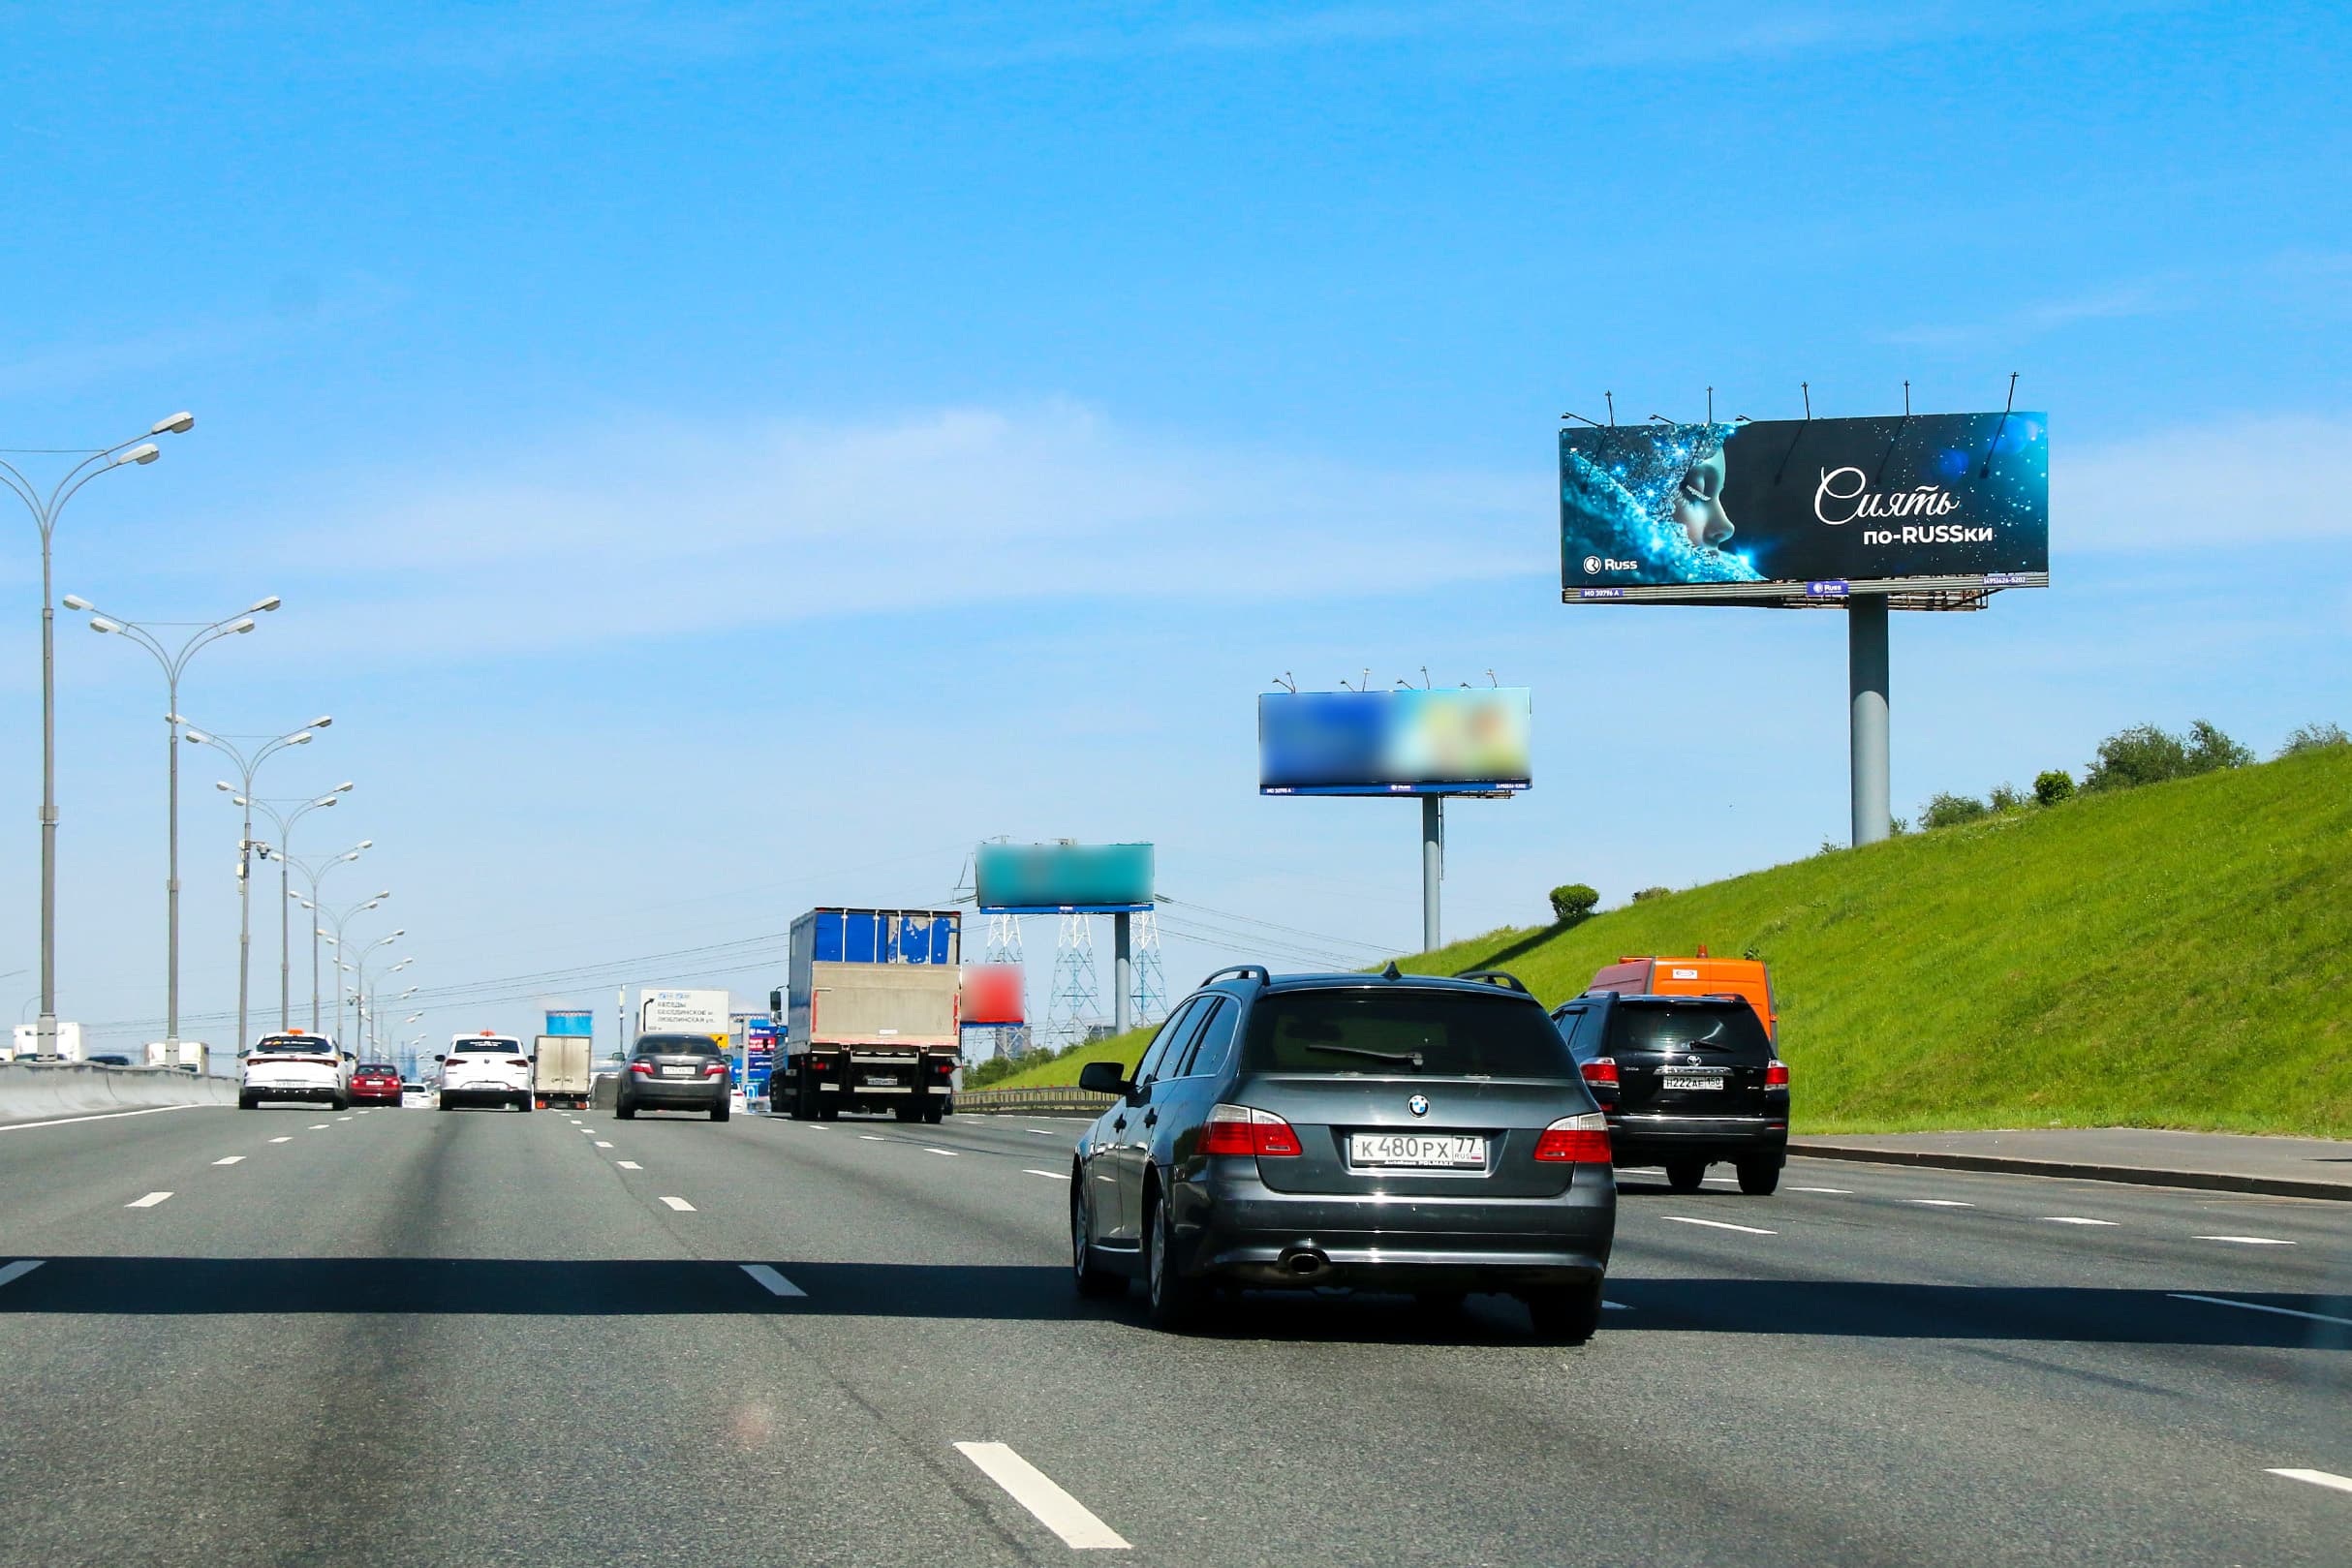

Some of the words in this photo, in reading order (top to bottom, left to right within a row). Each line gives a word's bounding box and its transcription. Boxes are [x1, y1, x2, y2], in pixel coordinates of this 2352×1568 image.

[1814, 466, 1961, 525] Сиять
[1863, 524, 1994, 545] по-RUSSки
[1604, 558, 1638, 570] Russ
